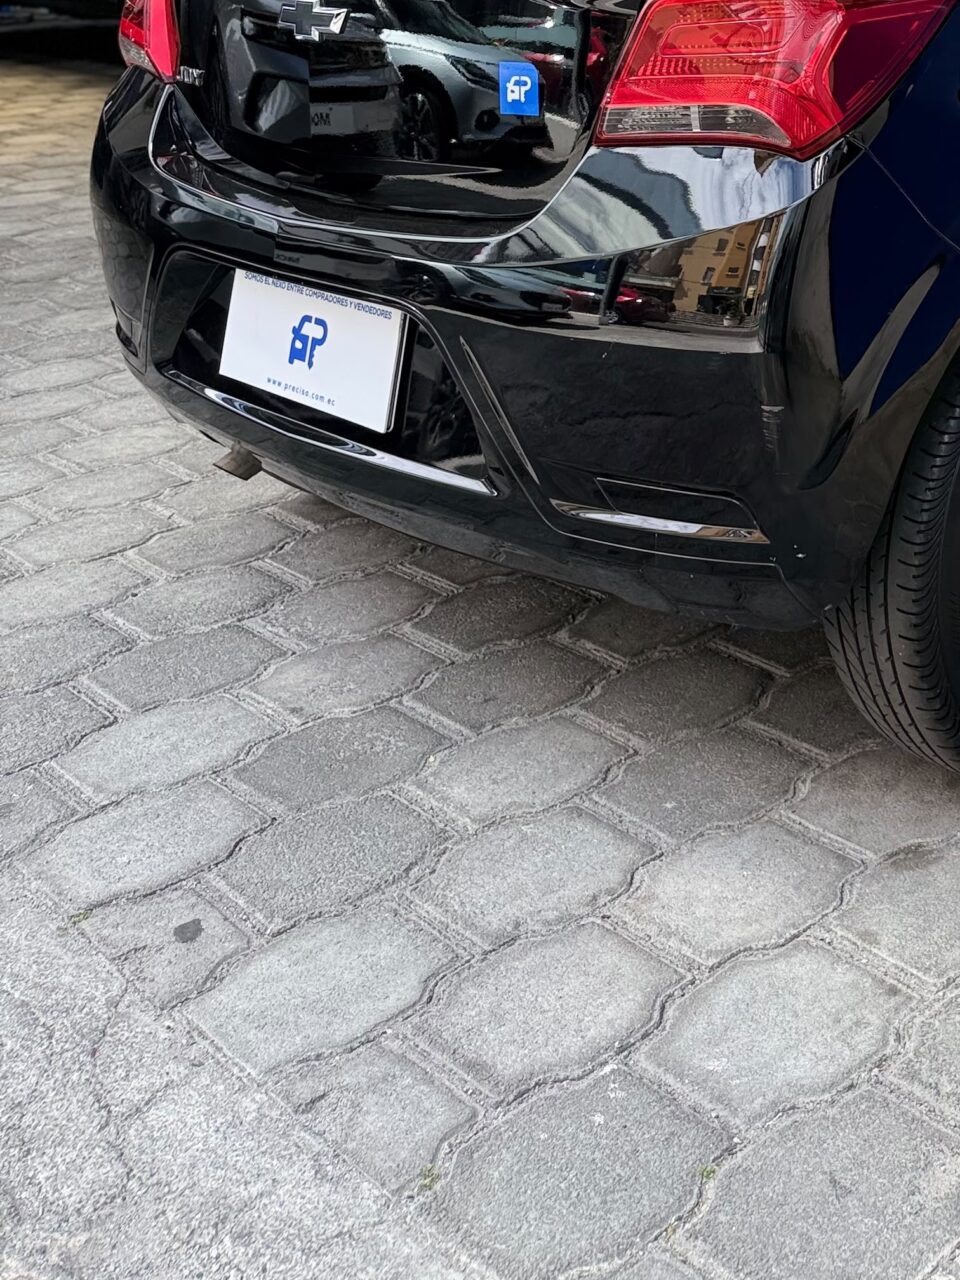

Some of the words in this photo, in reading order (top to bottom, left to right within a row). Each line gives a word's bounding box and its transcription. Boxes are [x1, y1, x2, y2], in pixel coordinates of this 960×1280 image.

[244, 271, 265, 284] SOMOS
[264, 277, 271, 286] EL
[272, 278, 286, 290] NEXO
[286, 284, 304, 295] ENTRE
[305, 288, 348, 308] COMPRADORES
[353, 301, 393, 320] VENDEDORES
